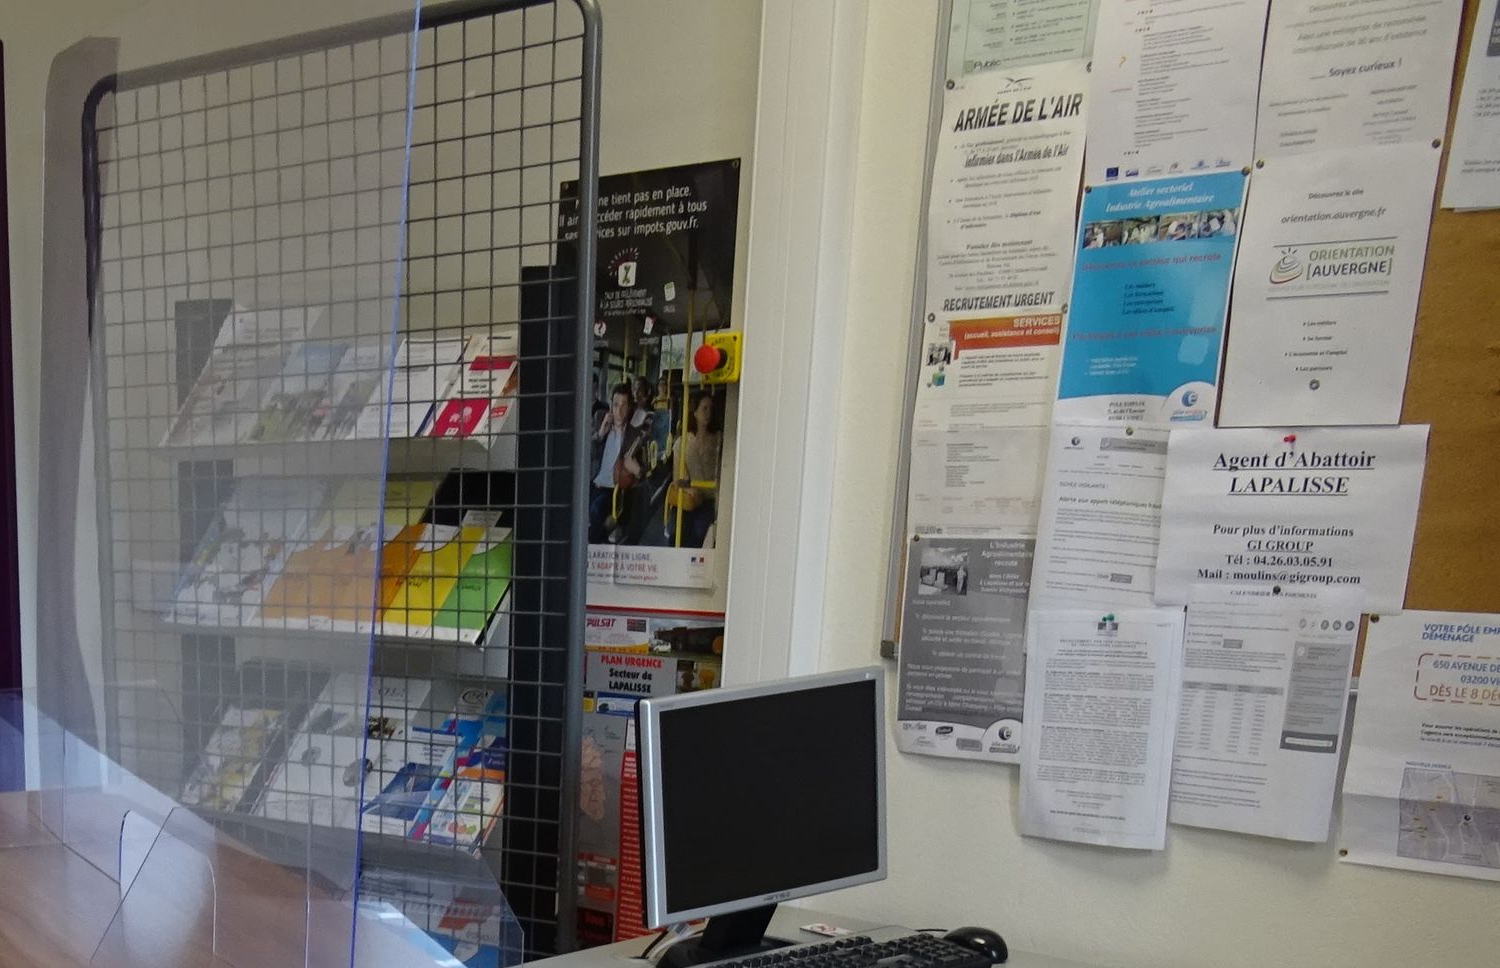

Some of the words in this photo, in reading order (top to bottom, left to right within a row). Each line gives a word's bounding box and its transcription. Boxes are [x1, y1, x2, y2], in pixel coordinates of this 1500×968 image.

[1329, 66, 1356, 78] Soyez
[1359, 60, 1396, 73] curieux
[954, 98, 1010, 133] ARMÉE
[1011, 98, 1036, 126] DE
[1038, 92, 1084, 121] L'AIR
[599, 194, 609, 207] ne
[611, 192, 632, 207] tient
[634, 190, 650, 206] pas
[652, 189, 663, 200] en
[666, 184, 692, 199] place.
[625, 204, 675, 222] rapidement
[678, 201, 684, 214] à
[687, 199, 707, 212] tous
[1281, 207, 1387, 225] orientation.auvergne.fr
[617, 226, 631, 238] sur
[1309, 244, 1396, 263] ORIENTATION
[943, 294, 1013, 312] RECRUTEMENT
[1014, 291, 1055, 308] URGENT
[1013, 315, 1061, 328] SERVICES
[1213, 452, 1269, 472] Agent
[1275, 450, 1377, 469] d'Abattoir
[1228, 476, 1350, 494] LAPALISSE
[1213, 524, 1240, 536] Pour
[1242, 524, 1266, 537] plus
[1268, 524, 1355, 537] d'informations
[1246, 539, 1262, 552] GI
[1265, 540, 1314, 552] GROUP
[1225, 553, 1244, 566] Tél
[1253, 555, 1334, 568] 04.26.03.05.91
[1197, 568, 1223, 580] Mail
[1233, 570, 1361, 585] moulins@gigroup.com
[1423, 623, 1455, 634] VOTRE
[1456, 623, 1480, 635] PÔLE
[1422, 632, 1475, 643] DÉMÉNAGE
[601, 654, 623, 666] PLAN
[624, 656, 663, 669] URGENCE
[1432, 659, 1450, 670] 650
[1451, 661, 1488, 673] AVENUE
[609, 668, 640, 680] Secteur
[642, 670, 652, 681] de
[1460, 674, 1489, 686] 03200
[608, 681, 652, 694] LAPALISSE
[1429, 684, 1452, 698] DÈS
[1454, 687, 1468, 699] LE
[1470, 688, 1479, 700] 8
